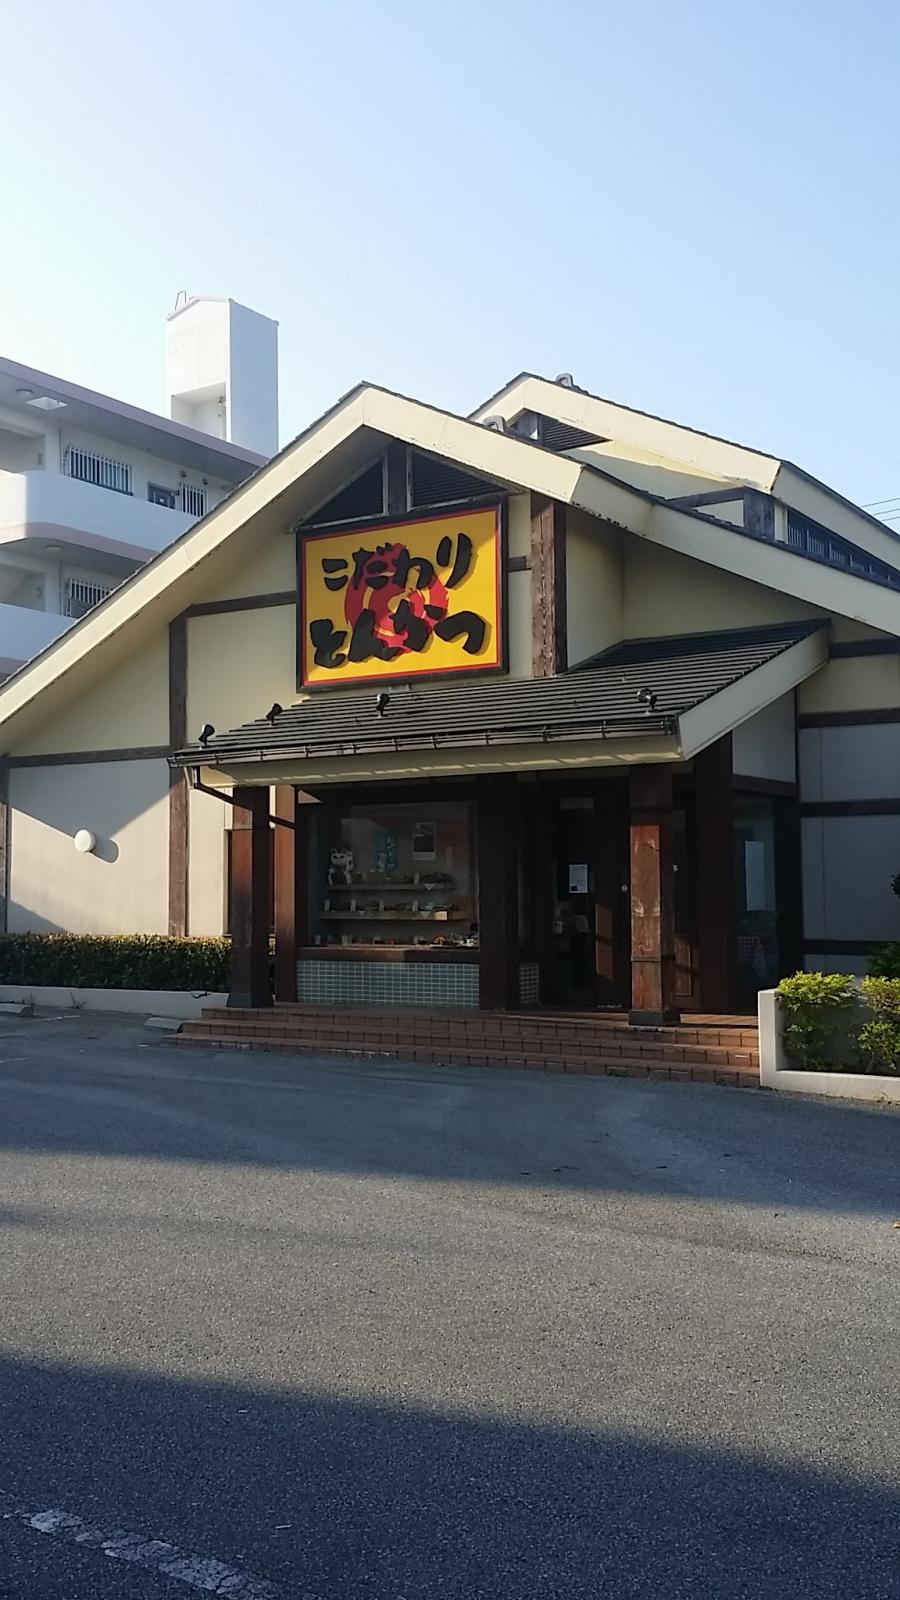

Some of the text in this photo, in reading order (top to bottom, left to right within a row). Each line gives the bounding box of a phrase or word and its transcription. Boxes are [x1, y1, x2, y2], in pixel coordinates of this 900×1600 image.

[322, 533, 473, 591] こだわり
[309, 599, 486, 669] とんかつ
